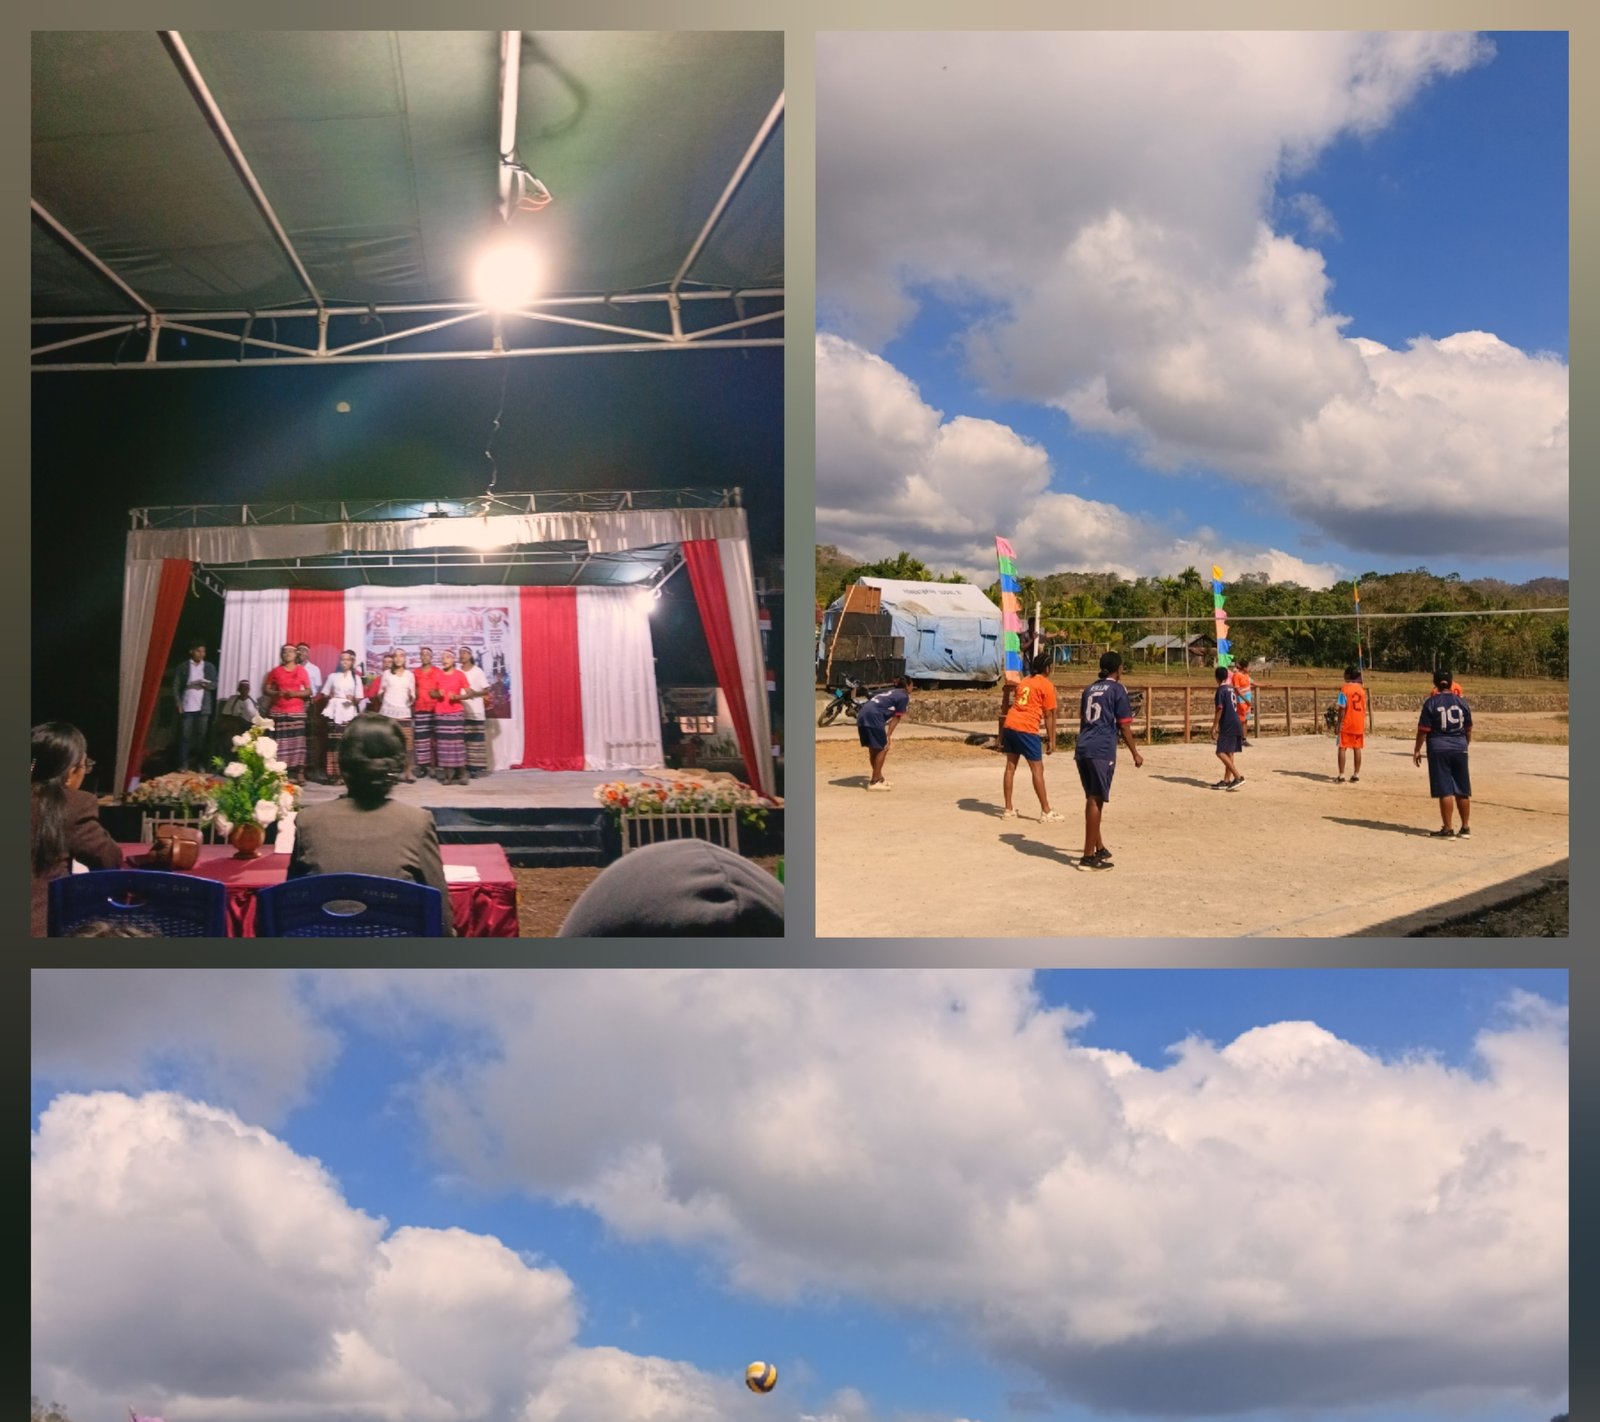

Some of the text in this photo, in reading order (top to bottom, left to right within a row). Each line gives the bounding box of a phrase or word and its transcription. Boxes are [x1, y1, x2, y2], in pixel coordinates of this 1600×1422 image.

[1018, 686, 1030, 705] 3
[1085, 691, 1104, 724] 6
[1351, 692, 1361, 711] 2
[1437, 704, 1465, 733] 19
